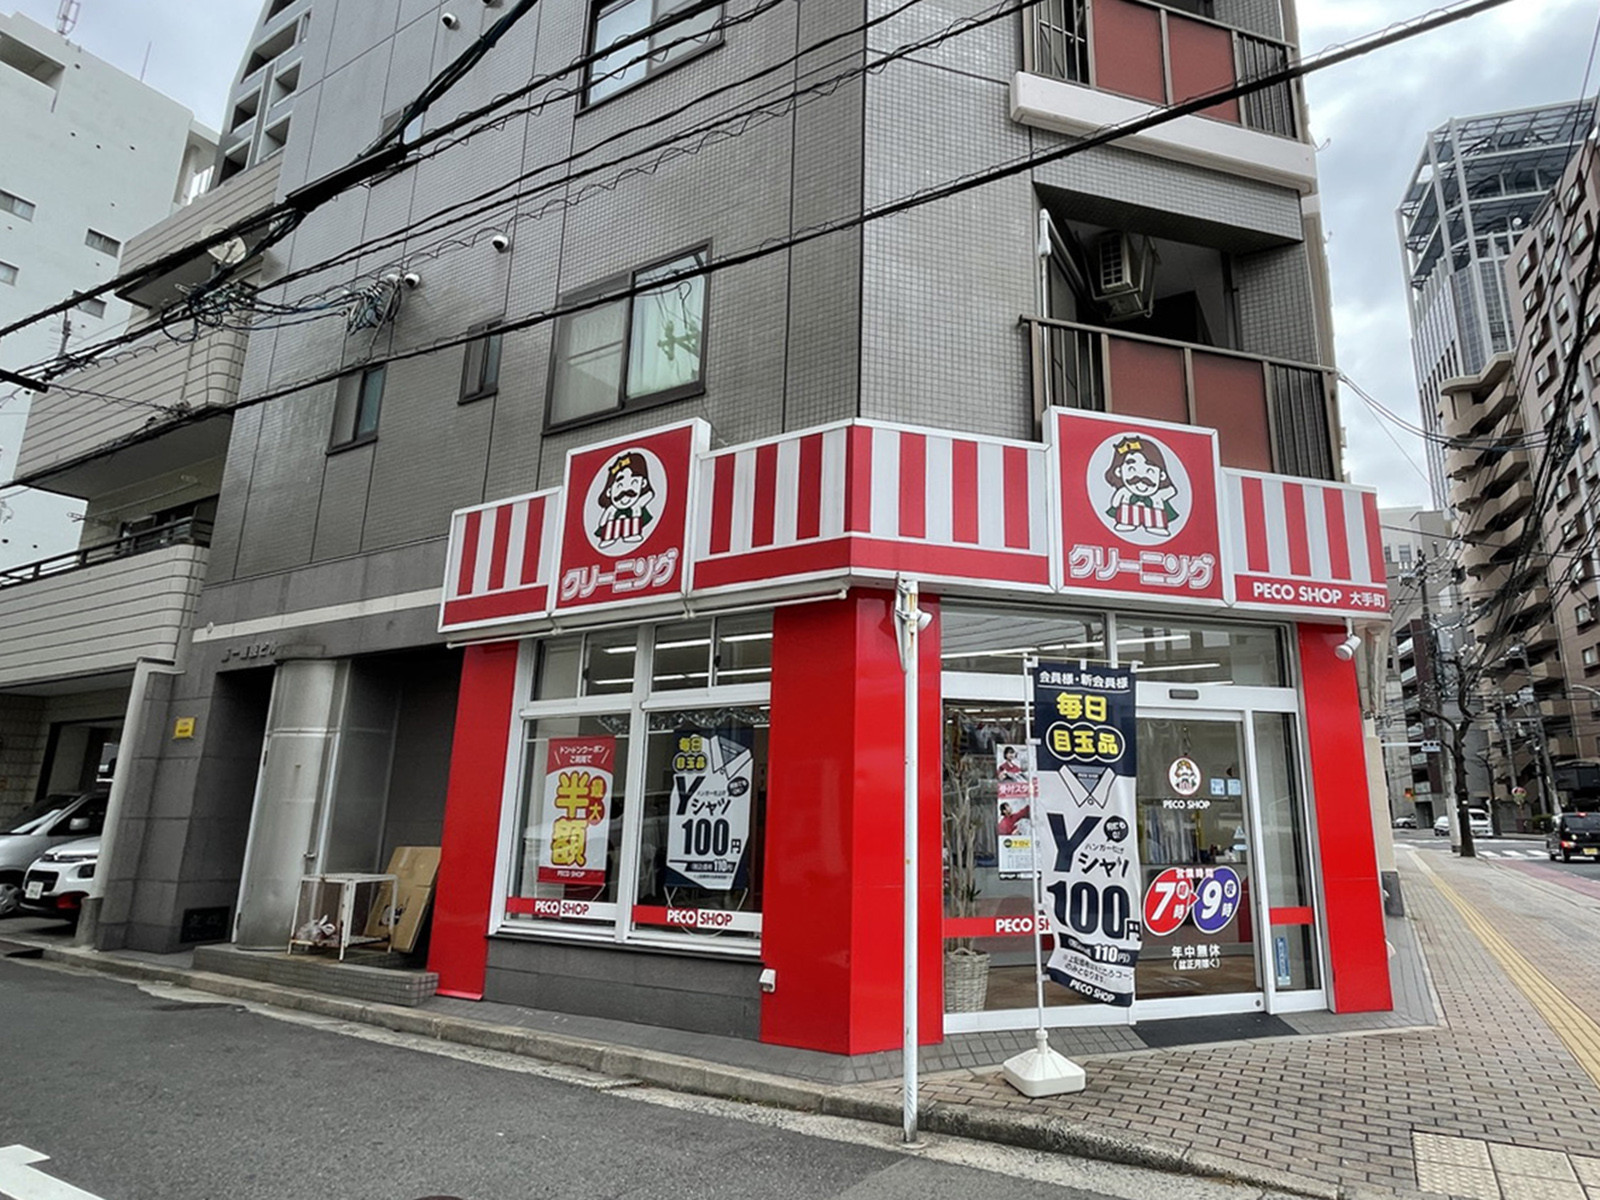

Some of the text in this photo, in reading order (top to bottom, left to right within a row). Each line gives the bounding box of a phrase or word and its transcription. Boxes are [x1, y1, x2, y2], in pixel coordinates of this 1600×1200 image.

[561, 547, 679, 601] クリーニング
[1069, 544, 1215, 589] クリーニング
[1253, 582, 1386, 608] PECO SHOP 大手町
[1056, 692, 1107, 722] 毎日
[1053, 729, 1119, 755] 目玉品
[1163, 800, 1210, 810] PECO SHOP
[552, 771, 589, 867] 半額
[535, 900, 589, 915] PECO SHOP
[667, 912, 732, 927] PECO SHOP
[995, 918, 1033, 933] PECO
[1171, 945, 1221, 959] 年中無休
[1069, 979, 1116, 1003] PECO SHOP
